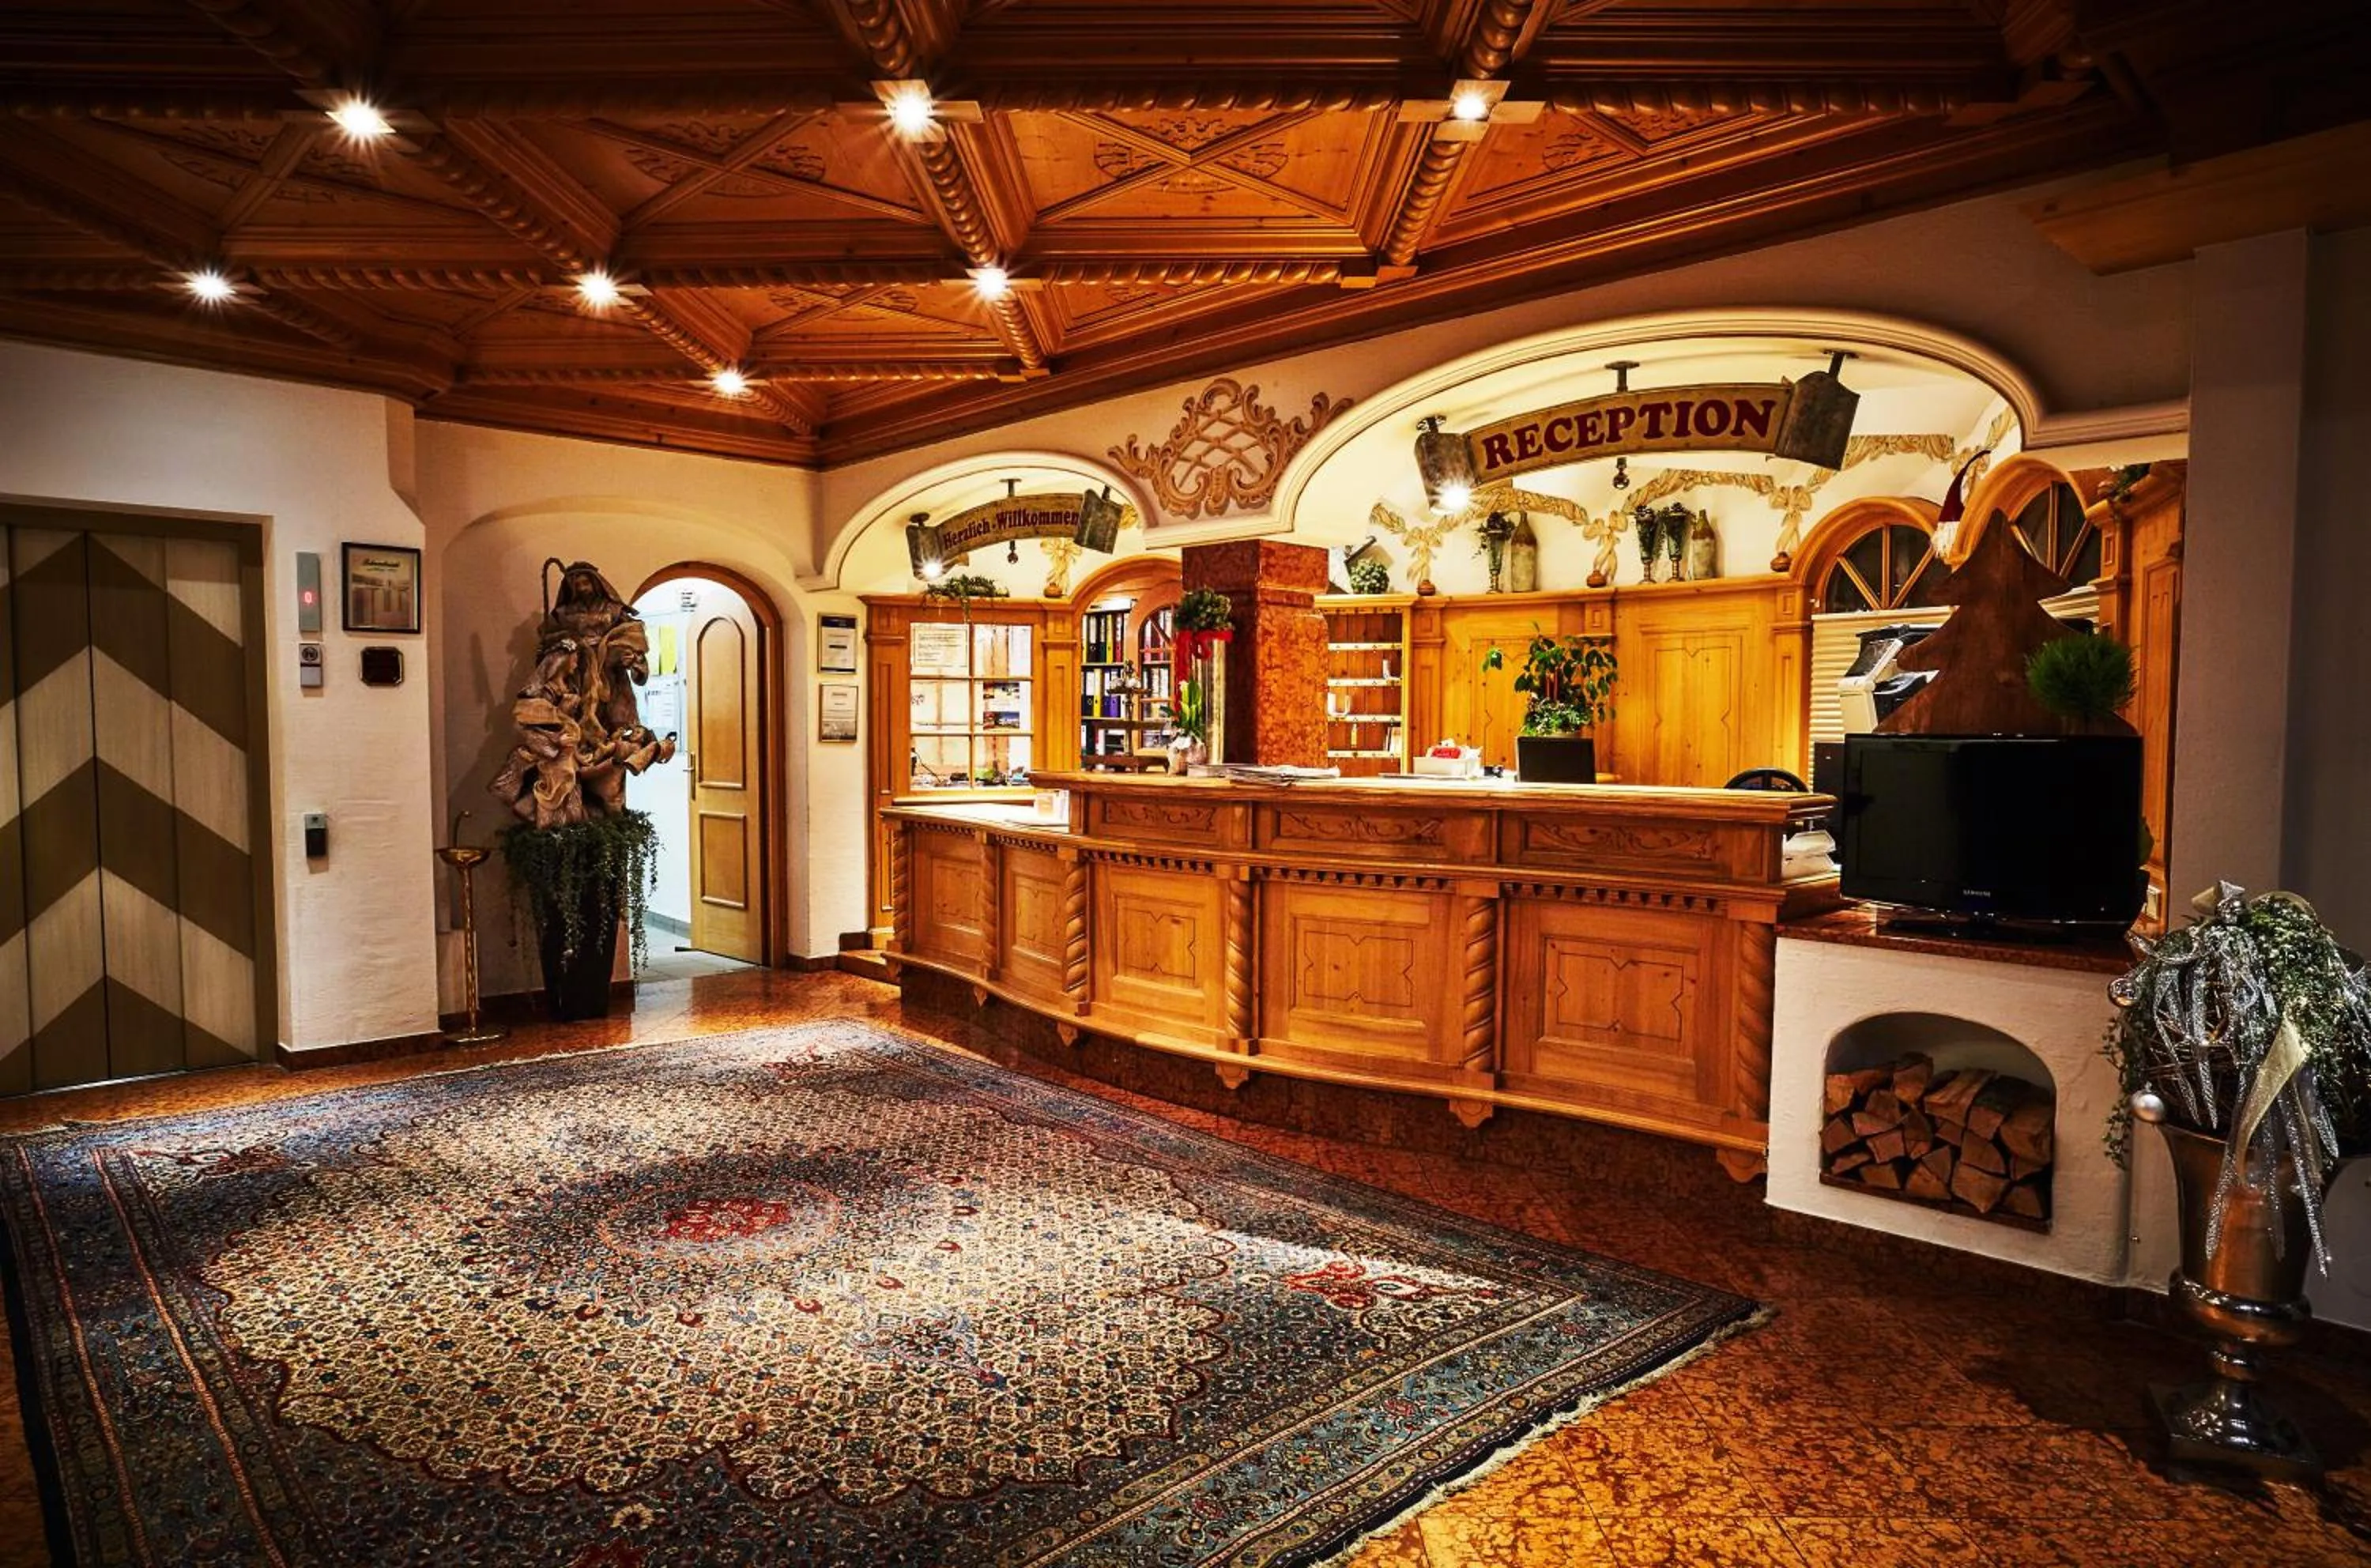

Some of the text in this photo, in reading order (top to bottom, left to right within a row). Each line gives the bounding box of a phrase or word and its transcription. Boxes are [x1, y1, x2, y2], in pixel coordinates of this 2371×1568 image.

[1482, 399, 1777, 469] RECEPTION
[944, 508, 1080, 549] Herzlich Willkommen
[303, 591, 313, 604] 0
